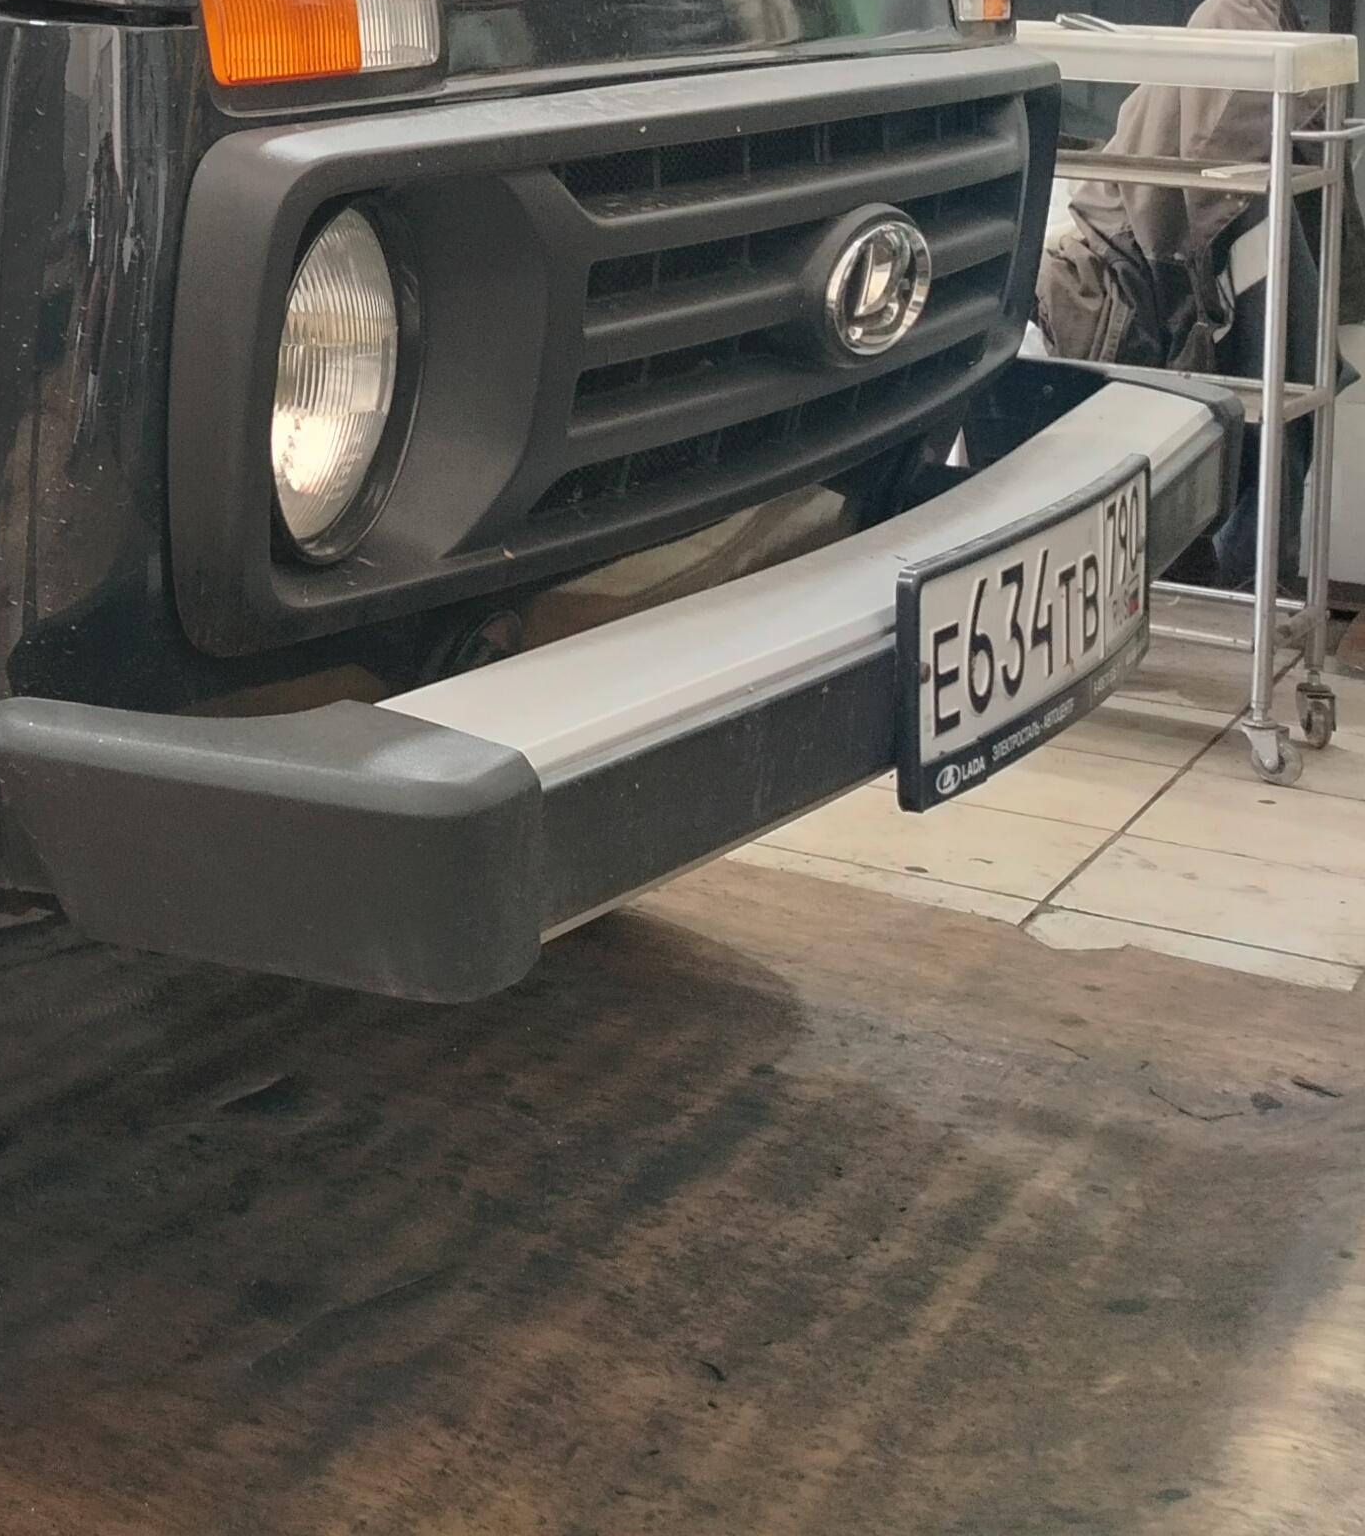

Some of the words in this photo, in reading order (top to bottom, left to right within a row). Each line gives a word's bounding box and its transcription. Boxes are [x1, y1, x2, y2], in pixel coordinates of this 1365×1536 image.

[1106, 484, 1139, 597] 790
[930, 548, 1100, 738] E634TB
[961, 755, 986, 781] LADA
